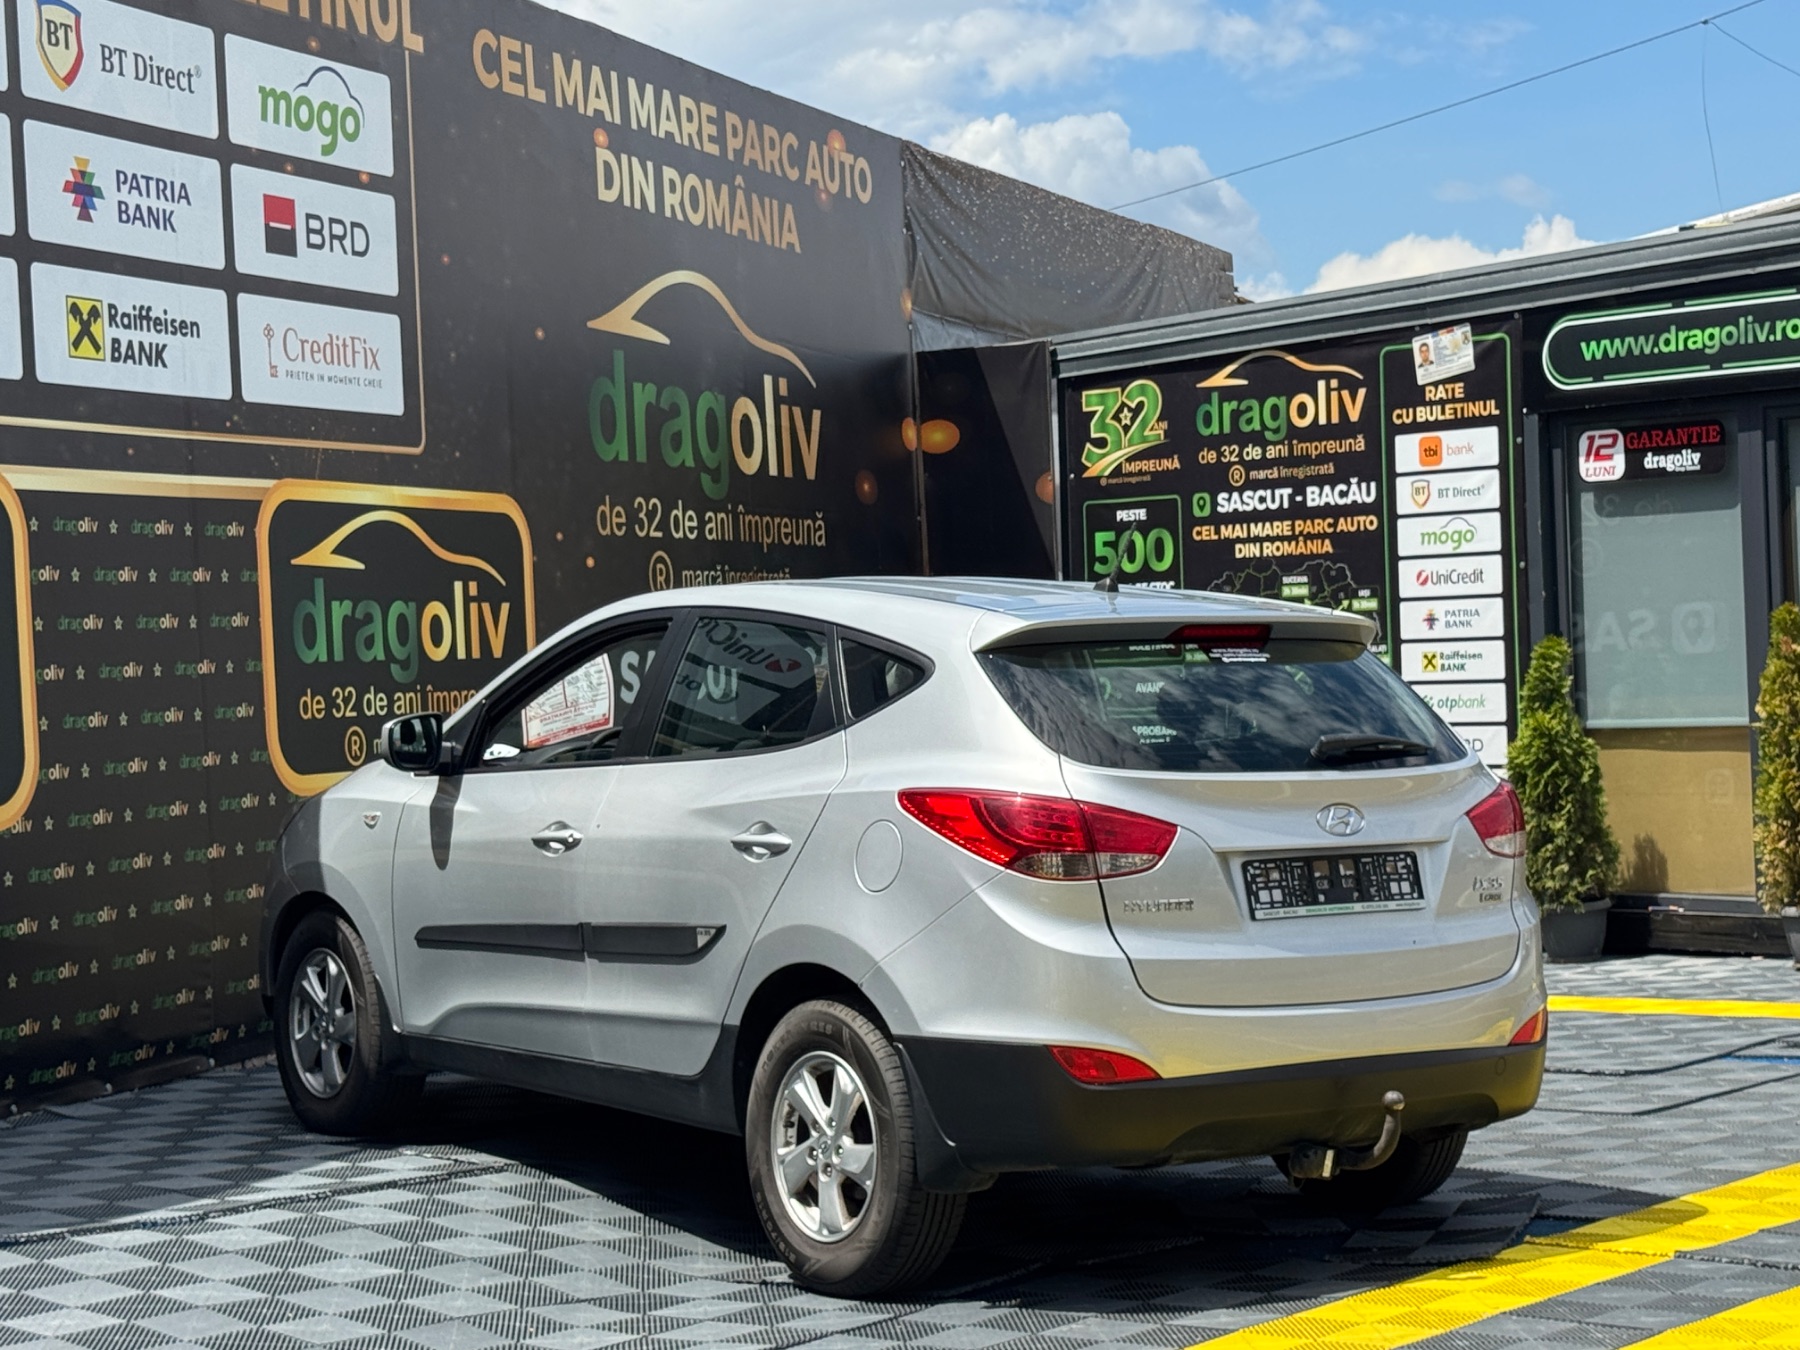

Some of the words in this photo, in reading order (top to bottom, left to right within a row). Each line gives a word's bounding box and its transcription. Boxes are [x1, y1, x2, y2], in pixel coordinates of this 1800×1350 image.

[46, 18, 73, 51] BT
[100, 44, 127, 77] BT
[258, 85, 361, 156] mogo
[472, 28, 546, 103] CEL
[553, 52, 620, 124] MAI
[628, 76, 720, 156] MARE
[725, 111, 799, 182] PARC
[805, 140, 872, 204] AUTO
[116, 170, 192, 206] PATRIA
[596, 146, 655, 213] DIN
[662, 165, 801, 254] ROMÂNIA
[117, 201, 177, 233] BANK
[305, 213, 370, 257] BRD
[107, 303, 201, 339] Raiffeisen
[282, 327, 381, 371] CreditFix
[1580, 315, 1800, 361] www.dragoliv.ro
[110, 338, 168, 368] BANK
[285, 369, 314, 382] PRIETEN
[317, 374, 325, 382] IN
[1425, 382, 1465, 402] RATE
[1081, 379, 1165, 468] 32
[1196, 379, 1367, 441] dragoliv
[1392, 408, 1413, 425] CU
[1416, 399, 1500, 422] BULETINUL
[588, 350, 821, 500] dragoliv
[1625, 424, 1721, 449] GARANTIE
[1198, 448, 1217, 464] de
[1221, 445, 1239, 463] 32
[1243, 443, 1262, 461] de
[1266, 440, 1289, 459] ani
[1292, 433, 1366, 459] împreună
[1423, 445, 1438, 458] tbi
[1446, 442, 1474, 457] bank
[1584, 432, 1620, 464] 12
[1643, 448, 1701, 472] dragoliv
[1122, 454, 1180, 474] ÎMPREUNĂ
[1250, 466, 1279, 480] marcă
[1280, 462, 1335, 479] înregistrată
[1585, 466, 1616, 478] LUNI
[1216, 487, 1293, 513] SASCUT
[1306, 477, 1377, 507] BACĂU
[1415, 486, 1426, 496] BT
[1438, 486, 1451, 499] BT
[53, 517, 98, 534] dragoliv
[131, 519, 174, 537] dragoliv
[204, 522, 245, 539] dragoliv
[597, 495, 627, 536] de
[634, 497, 663, 537] 32
[670, 500, 698, 540] de
[705, 504, 734, 541] ani
[737, 503, 827, 553] împreună
[1116, 508, 1147, 522] PESTE
[1192, 525, 1219, 541] CEL
[1220, 523, 1248, 540] MAI
[1250, 520, 1293, 538] MARE
[1294, 517, 1335, 536] PARC
[1336, 515, 1378, 533] AUTO
[1093, 528, 1175, 575] 500
[1235, 542, 1262, 559] DIN
[1263, 537, 1333, 558] ROMÂNIA
[1420, 529, 1476, 551] mogo
[31, 565, 60, 585] goliv
[93, 566, 138, 585] dragoliv
[170, 567, 211, 585] dragoliv
[1430, 568, 1484, 585] UniCredit
[58, 614, 103, 634] dragoliv
[136, 613, 179, 632] dragoliv
[209, 612, 249, 630] dragoliv
[1444, 608, 1480, 618] PATRIA
[1444, 620, 1473, 629] BANK
[293, 578, 510, 684] dragoliv
[1439, 651, 1483, 661] Raiffeisen
[1440, 663, 1467, 672] BANK
[36, 664, 64, 684] goliv
[99, 662, 143, 681] dragoliv
[174, 659, 216, 678] dragoliv
[62, 712, 108, 731] dragoliv
[140, 707, 184, 726] dragoliv
[214, 702, 254, 720] dragoliv
[300, 688, 326, 720] de
[332, 687, 357, 718] 32
[363, 686, 388, 716] de
[394, 685, 422, 715] ani
[1437, 695, 1486, 712] otpbank
[103, 759, 148, 778] dragoliv
[179, 751, 221, 771] dragoliv
[67, 809, 113, 830] dragoliv
[146, 801, 189, 821] dragoliv
[219, 793, 260, 812] dragoliv
[28, 863, 75, 884] dragoliv
[108, 853, 153, 874] dragoliv
[184, 843, 226, 864] dragoliv
[73, 907, 118, 928] dragoliv
[152, 895, 194, 916] dragoliv
[224, 884, 265, 904] dragoliv
[32, 962, 79, 985] dragoliv
[112, 949, 156, 970] dragoliv
[75, 1004, 120, 1026] dragoliv
[225, 974, 260, 995] dragoli
[29, 1061, 77, 1084] dragoliv
